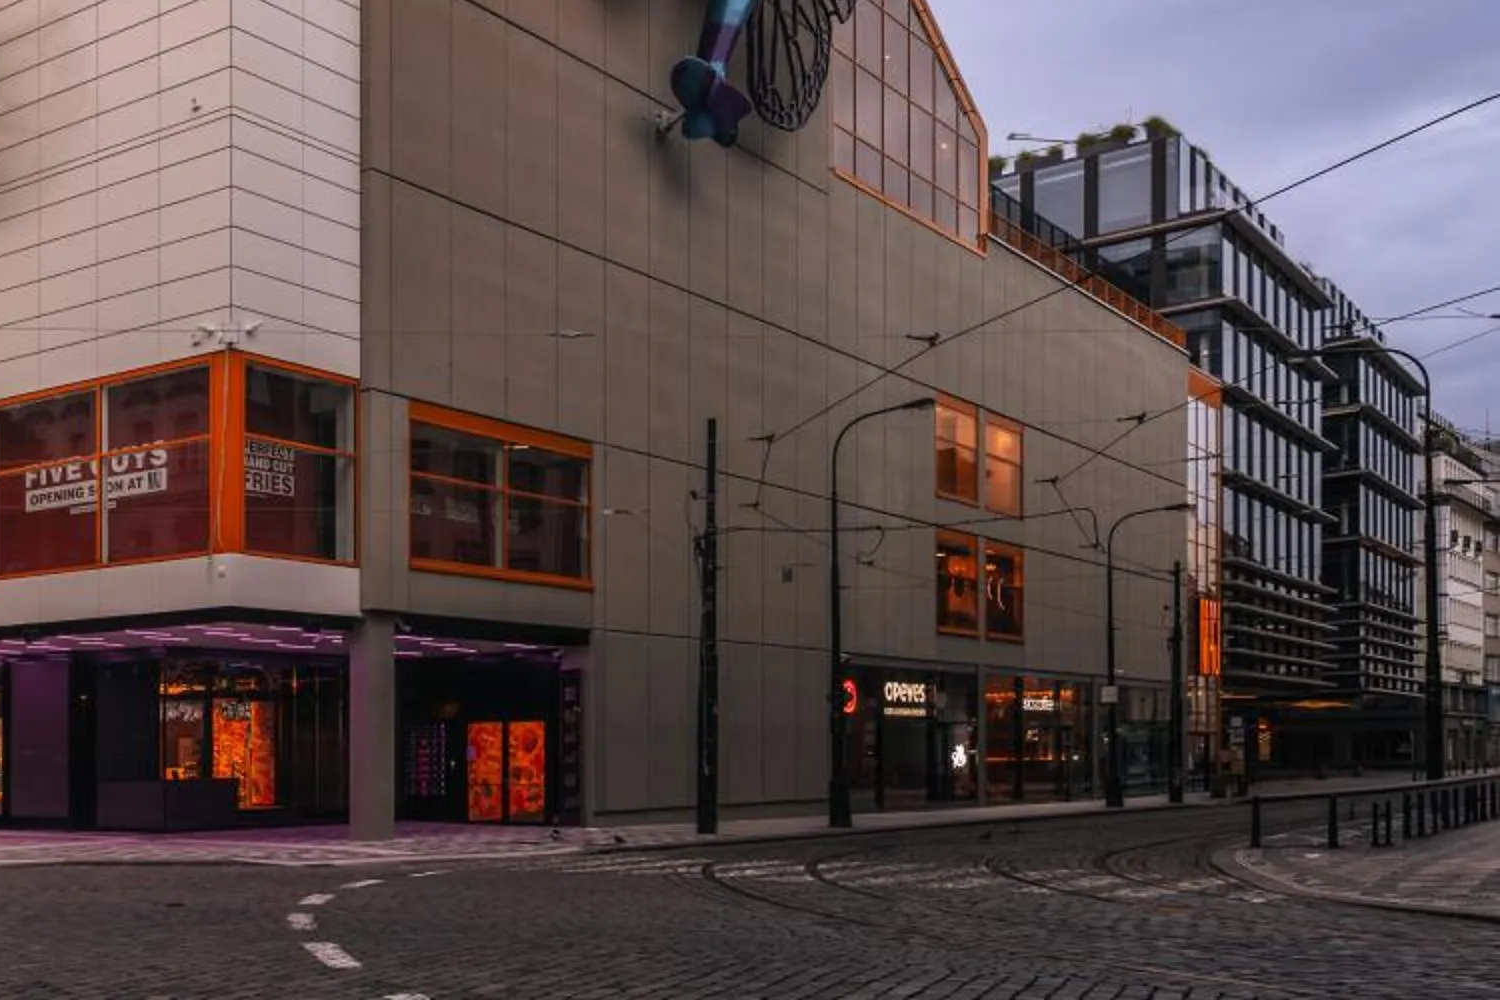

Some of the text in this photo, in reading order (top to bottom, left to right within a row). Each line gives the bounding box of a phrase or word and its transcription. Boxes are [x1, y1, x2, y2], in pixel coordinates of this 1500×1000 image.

[25, 440, 168, 489] FIVE UYS
[30, 486, 85, 507] OPENING
[88, 479, 123, 497] SON
[127, 476, 144, 491] AT
